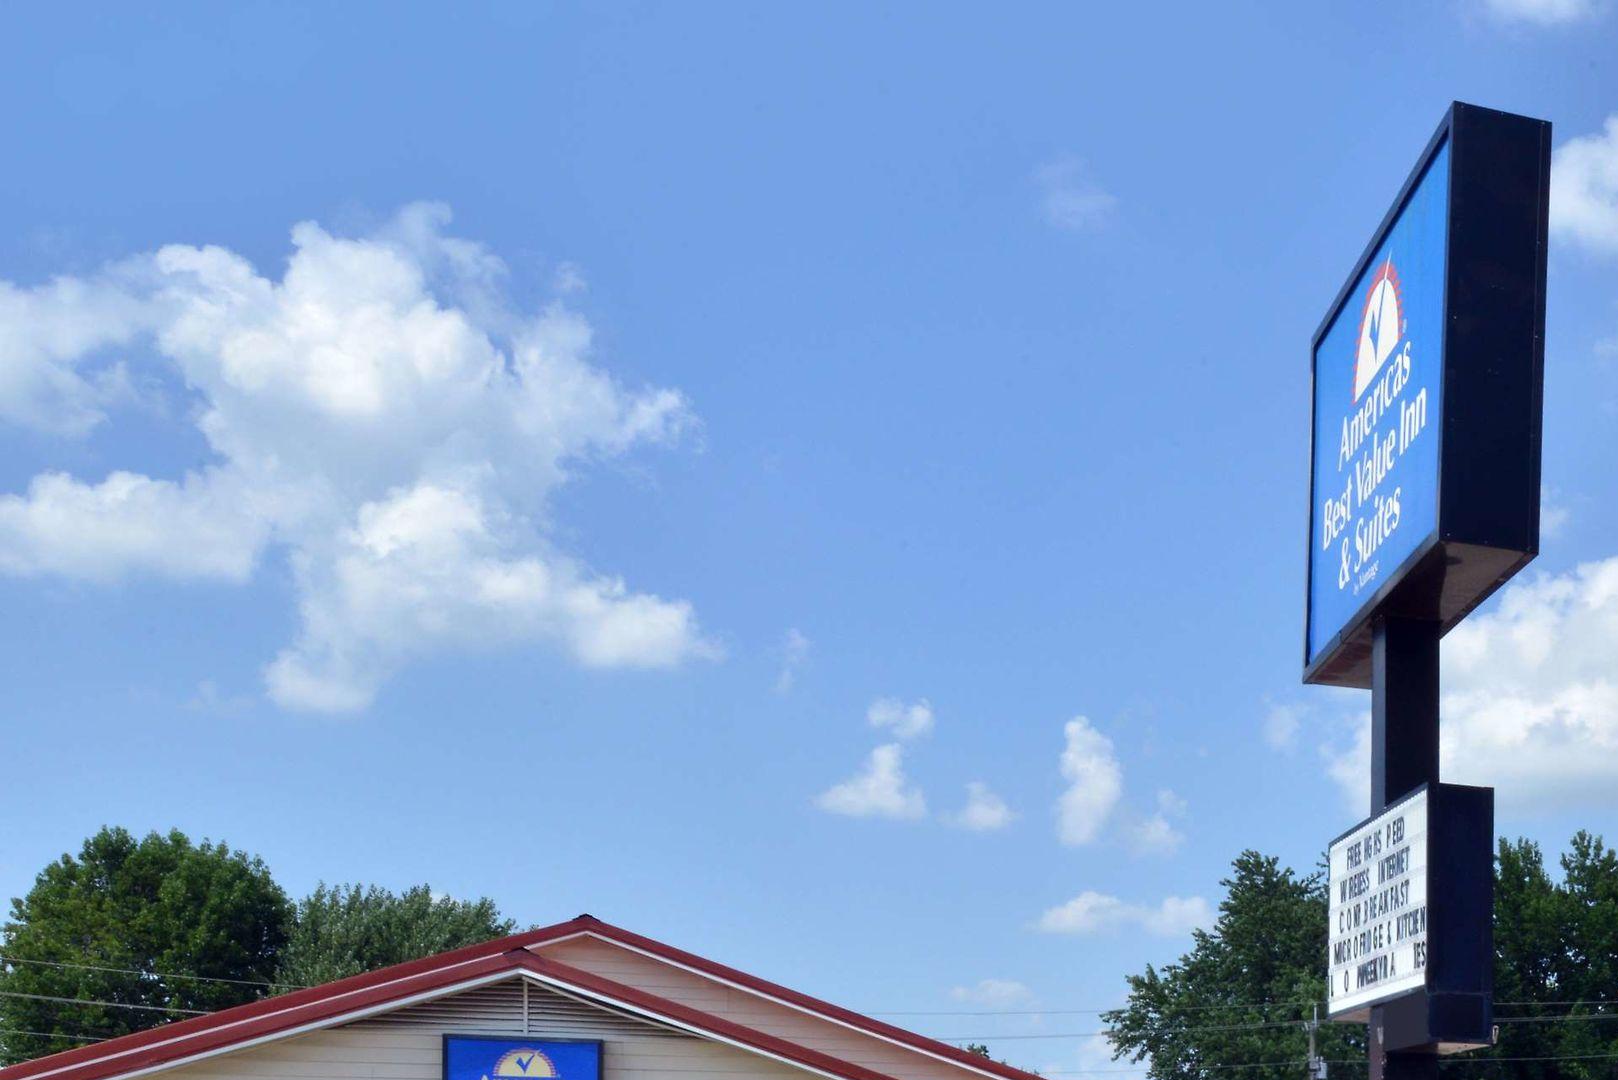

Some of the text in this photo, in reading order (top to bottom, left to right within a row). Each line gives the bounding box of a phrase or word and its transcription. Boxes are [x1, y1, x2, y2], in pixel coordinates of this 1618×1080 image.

[1338, 341, 1411, 472] Americas
[1323, 387, 1427, 551] Best Value Inn
[1338, 487, 1401, 590] & Suites
[1346, 841, 1361, 871] FREE
[1378, 846, 1410, 885] INTERNET
